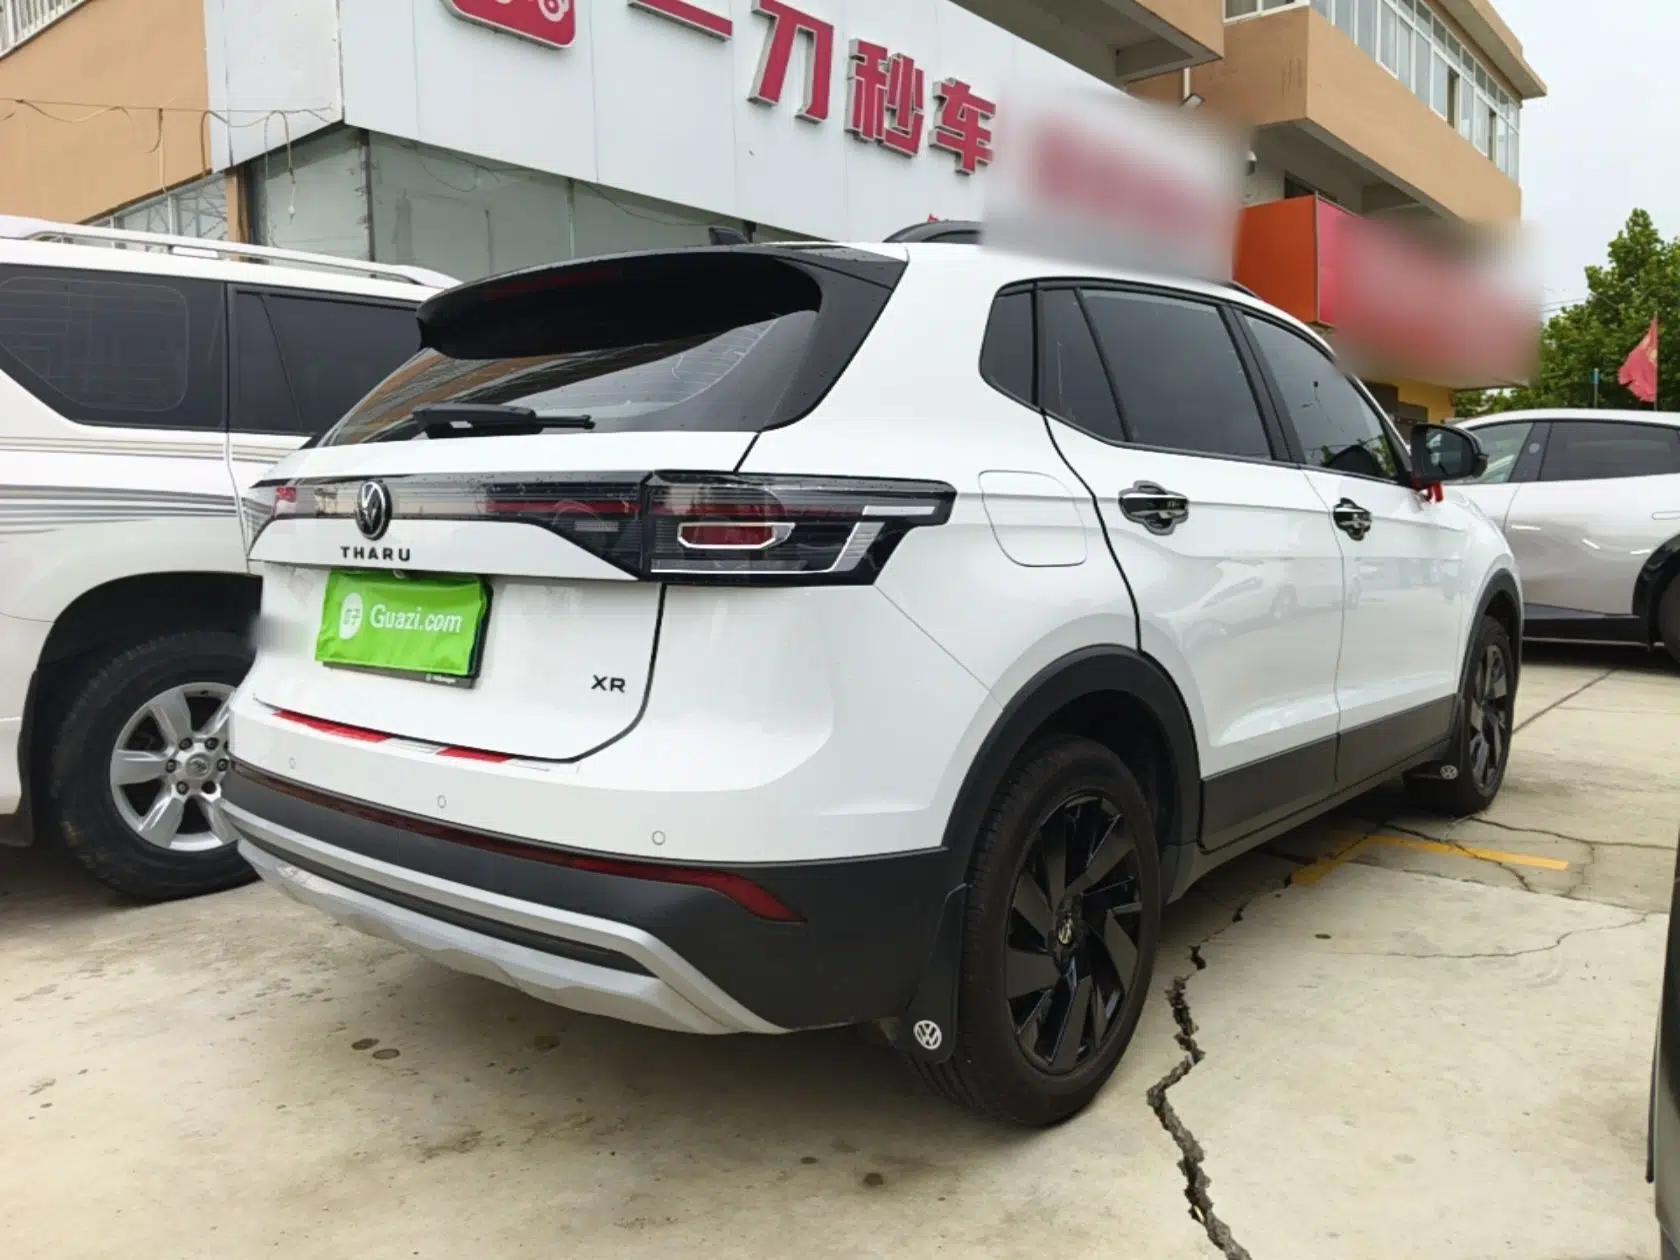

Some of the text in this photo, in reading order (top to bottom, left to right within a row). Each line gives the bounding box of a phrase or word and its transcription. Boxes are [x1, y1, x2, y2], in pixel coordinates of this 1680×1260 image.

[340, 546, 411, 562] THARU
[369, 603, 463, 633] Guazi.com
[591, 674, 626, 693] XR
